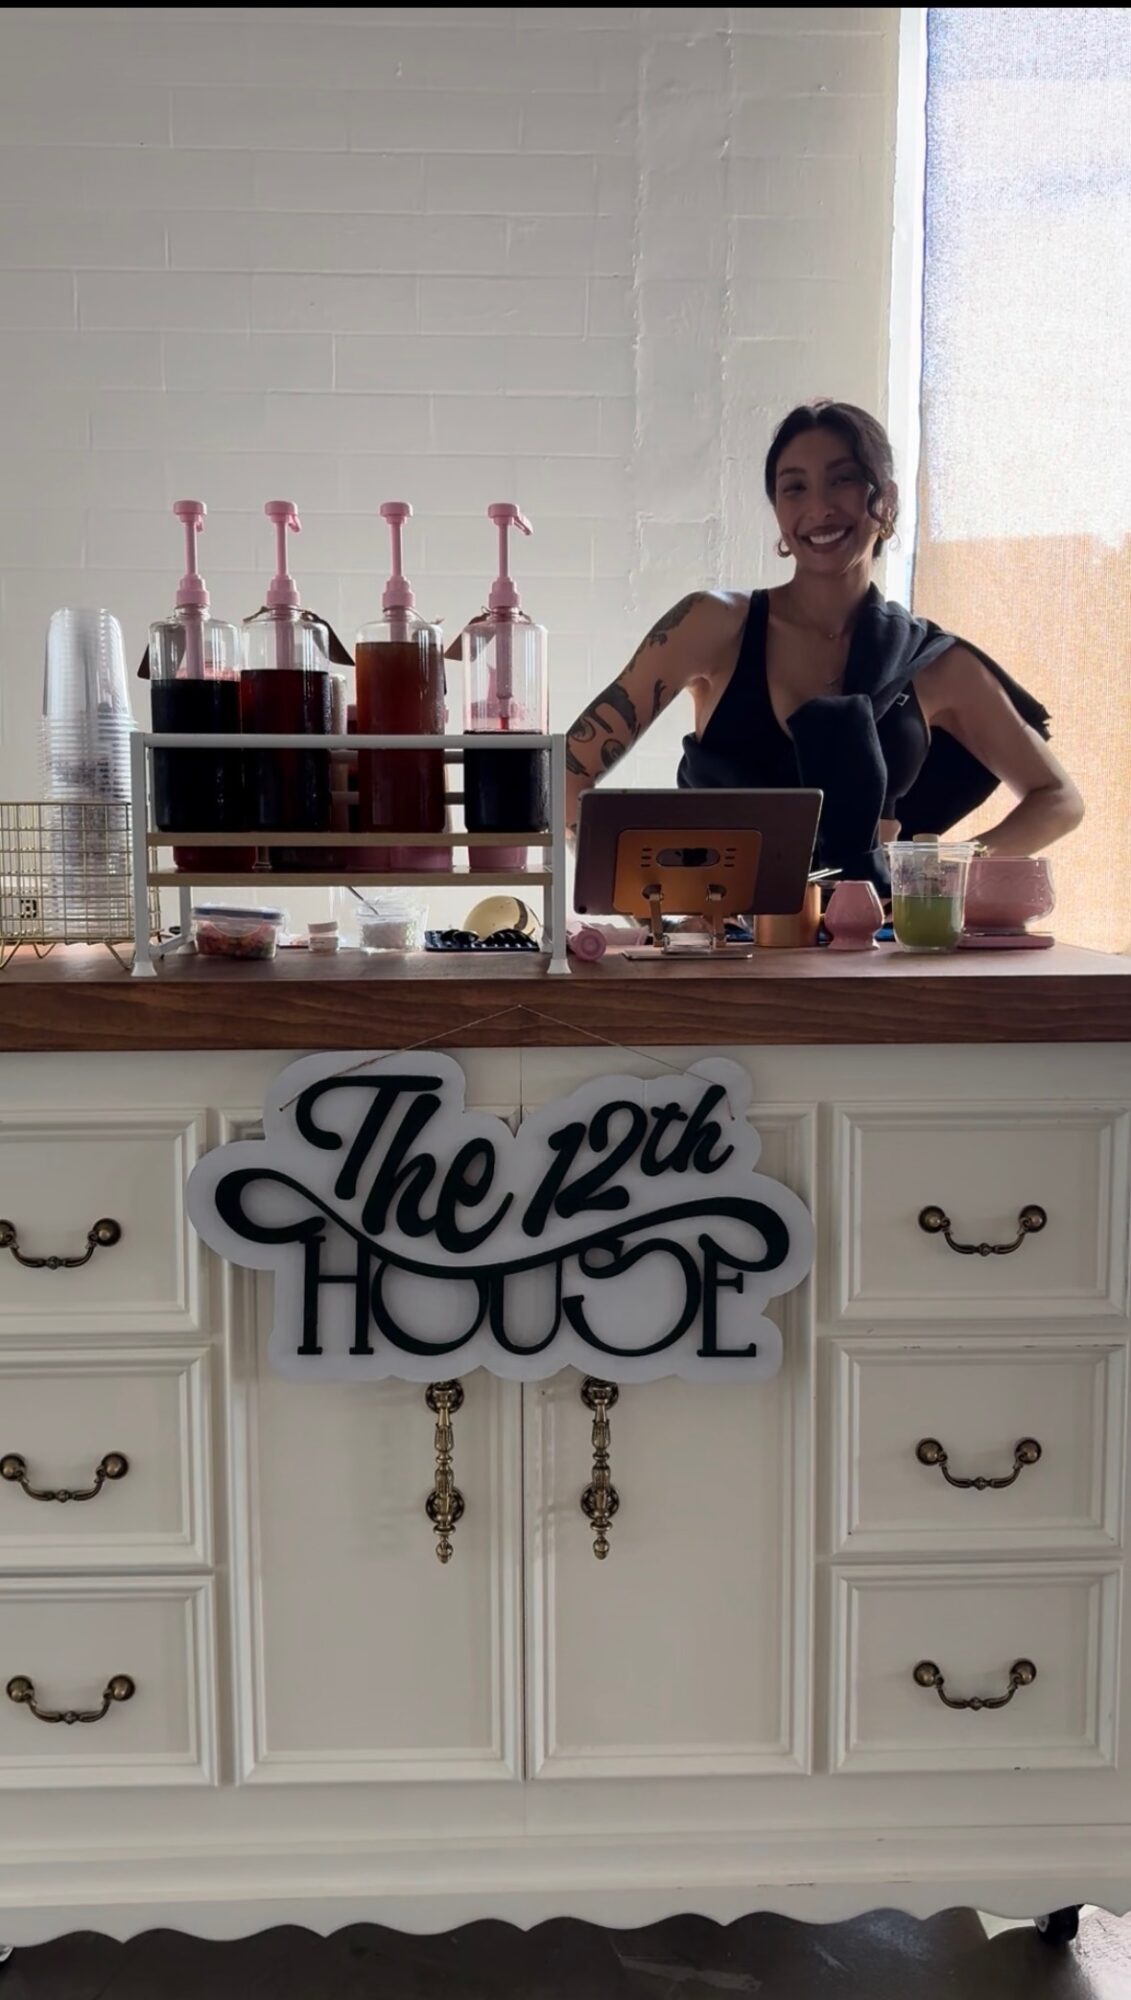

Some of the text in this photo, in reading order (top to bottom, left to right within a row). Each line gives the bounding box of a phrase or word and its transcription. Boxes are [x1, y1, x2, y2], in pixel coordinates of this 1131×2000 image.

[295, 1075, 735, 1254] The 12th
[297, 1220, 757, 1358] HOUSE
